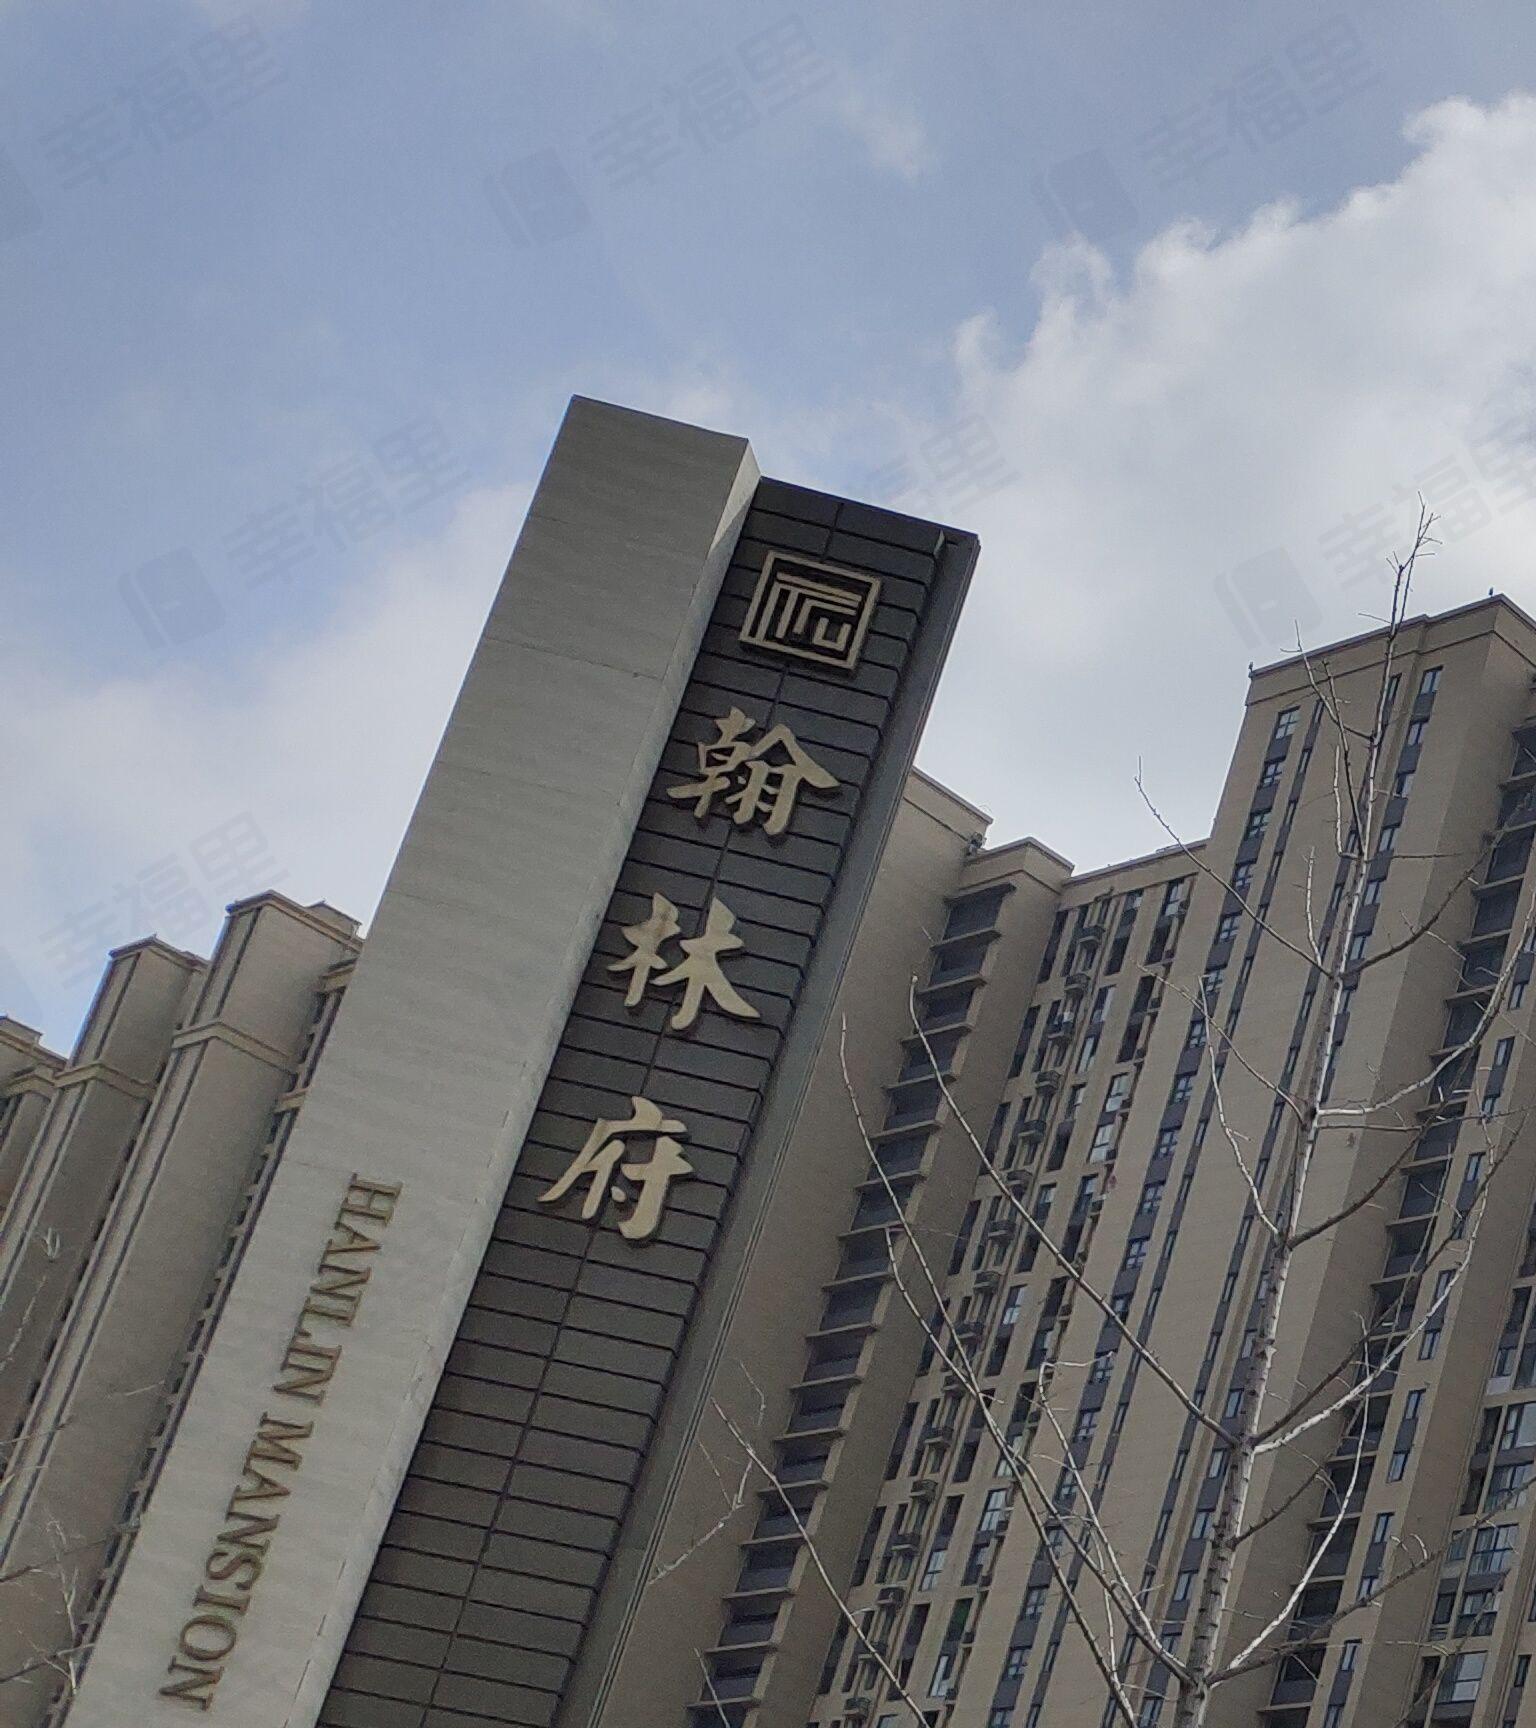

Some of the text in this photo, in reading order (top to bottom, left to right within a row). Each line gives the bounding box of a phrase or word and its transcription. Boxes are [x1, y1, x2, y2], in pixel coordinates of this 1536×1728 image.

[539, 706, 841, 1240] 翰林府
[158, 1172, 404, 1711] HANLIN MANSION
